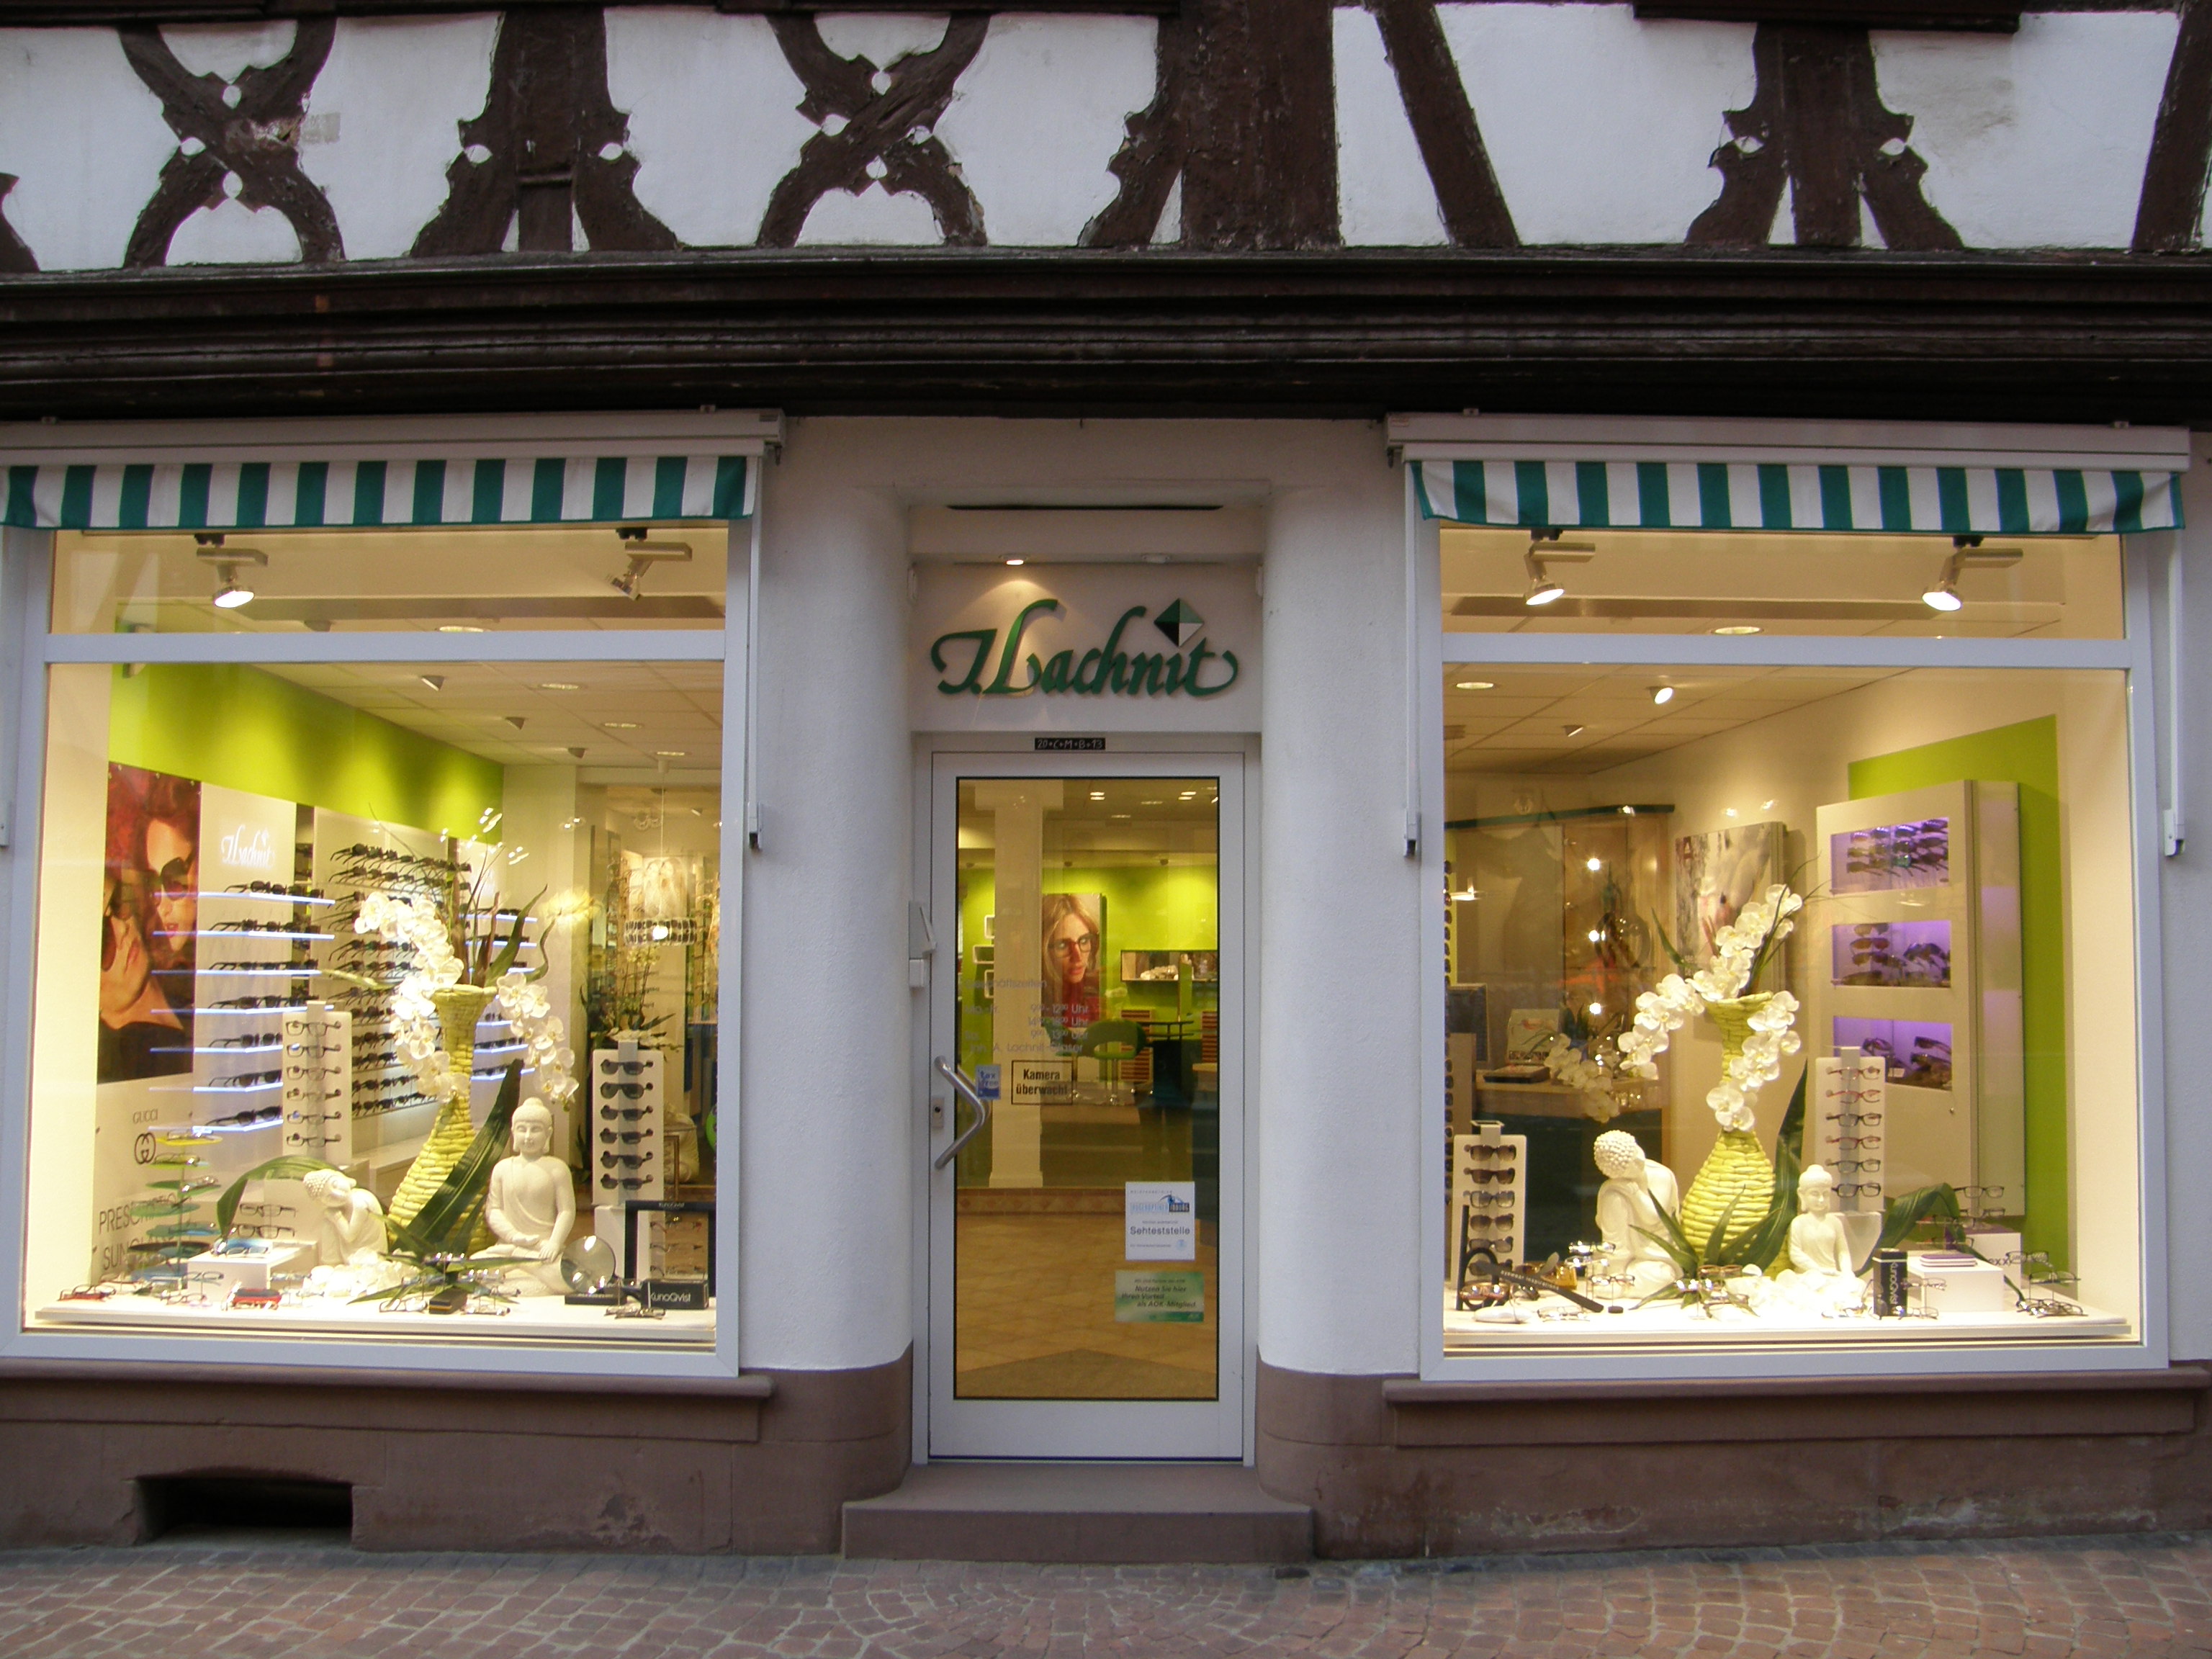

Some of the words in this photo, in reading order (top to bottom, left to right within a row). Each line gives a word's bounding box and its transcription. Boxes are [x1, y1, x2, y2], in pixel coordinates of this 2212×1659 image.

[1071, 1004, 1089, 1014] Uhr
[1071, 1017, 1089, 1027] Uhr
[1023, 1069, 1061, 1080] Kamera
[1016, 1084, 1068, 1095] überwacht
[132, 1109, 158, 1124] GUCCI
[1130, 1226, 1190, 1236] Sehteststelle
